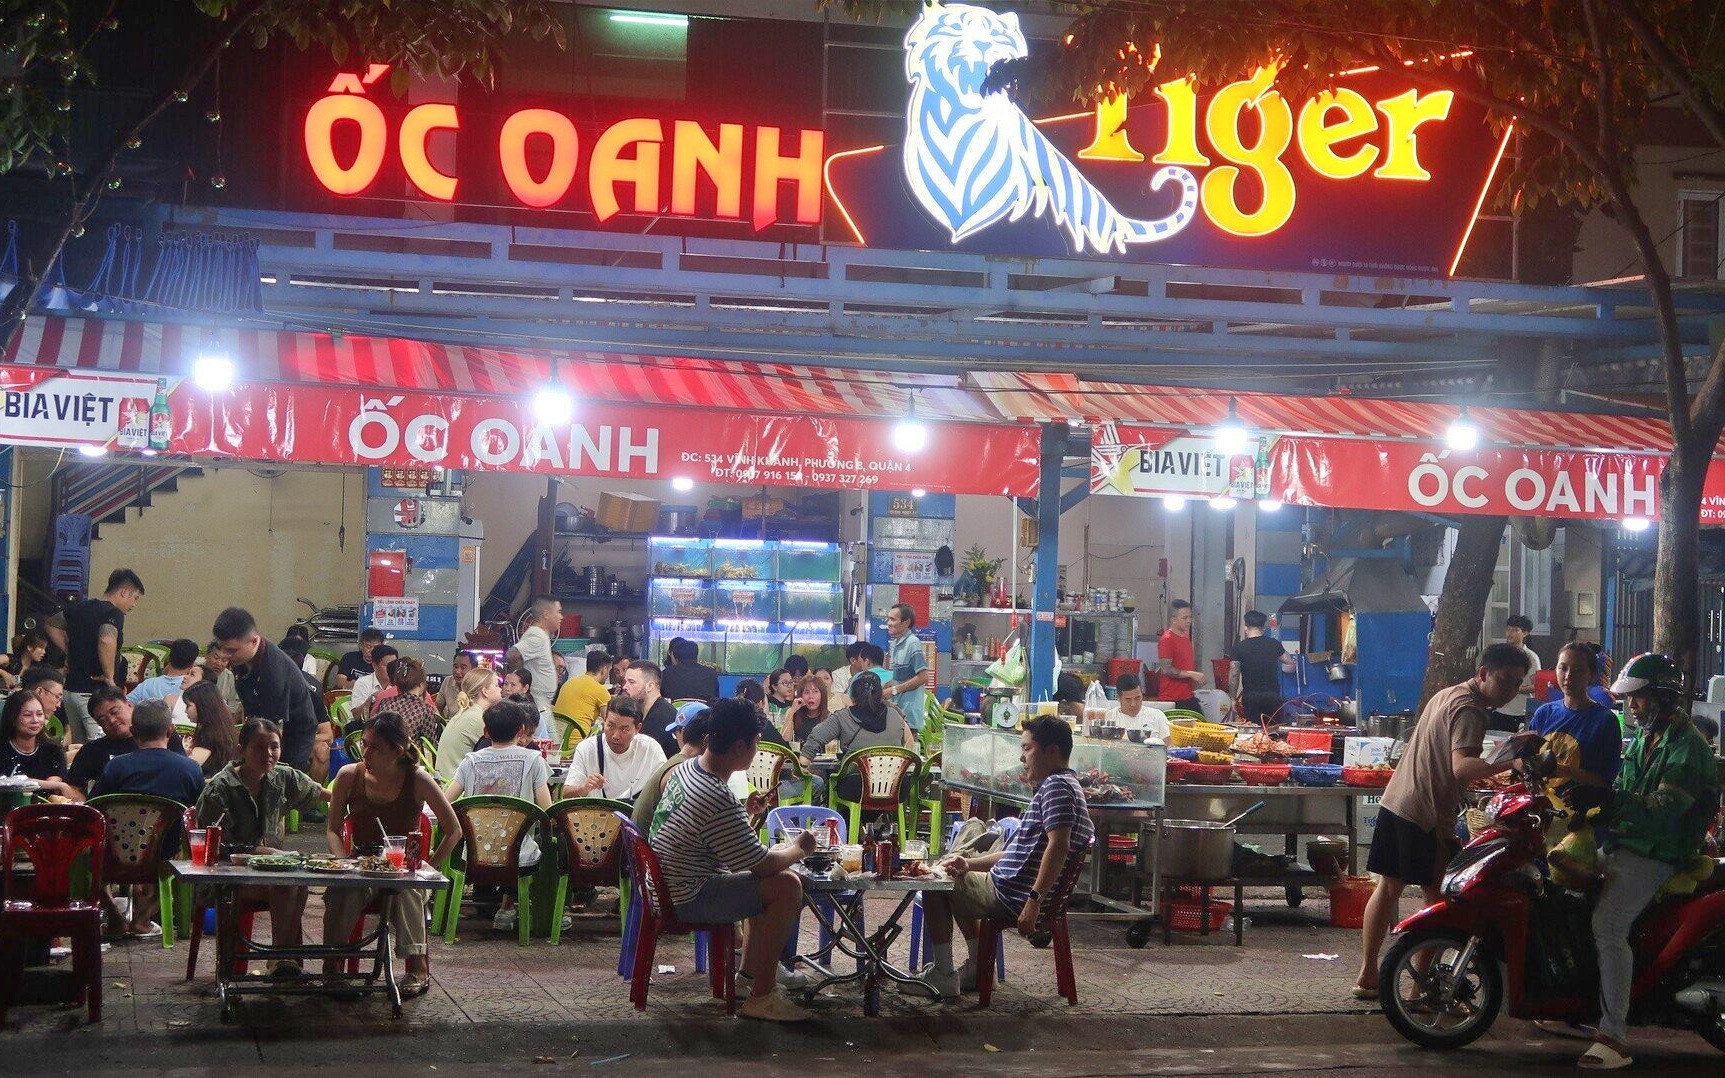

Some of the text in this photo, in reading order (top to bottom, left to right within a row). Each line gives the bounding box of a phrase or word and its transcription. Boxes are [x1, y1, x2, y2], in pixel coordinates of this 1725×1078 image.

[304, 64, 824, 232] ỐC OANH
[54, 392, 114, 426] VIỆT
[348, 395, 660, 474] ỐC OANH
[681, 452, 702, 462] ĐC:
[704, 453, 724, 464] 534
[868, 459, 903, 474] QUẬN
[904, 463, 912, 473] 4
[735, 469, 761, 479] 097
[763, 470, 782, 480] 916
[784, 471, 803, 480] 15
[811, 472, 837, 482] 0937
[838, 474, 857, 484] 327
[859, 475, 879, 484] 269
[1407, 449, 1655, 516] ỐC OANH
[893, 498, 914, 510] 534
[1701, 509, 1716, 518] ĐT:
